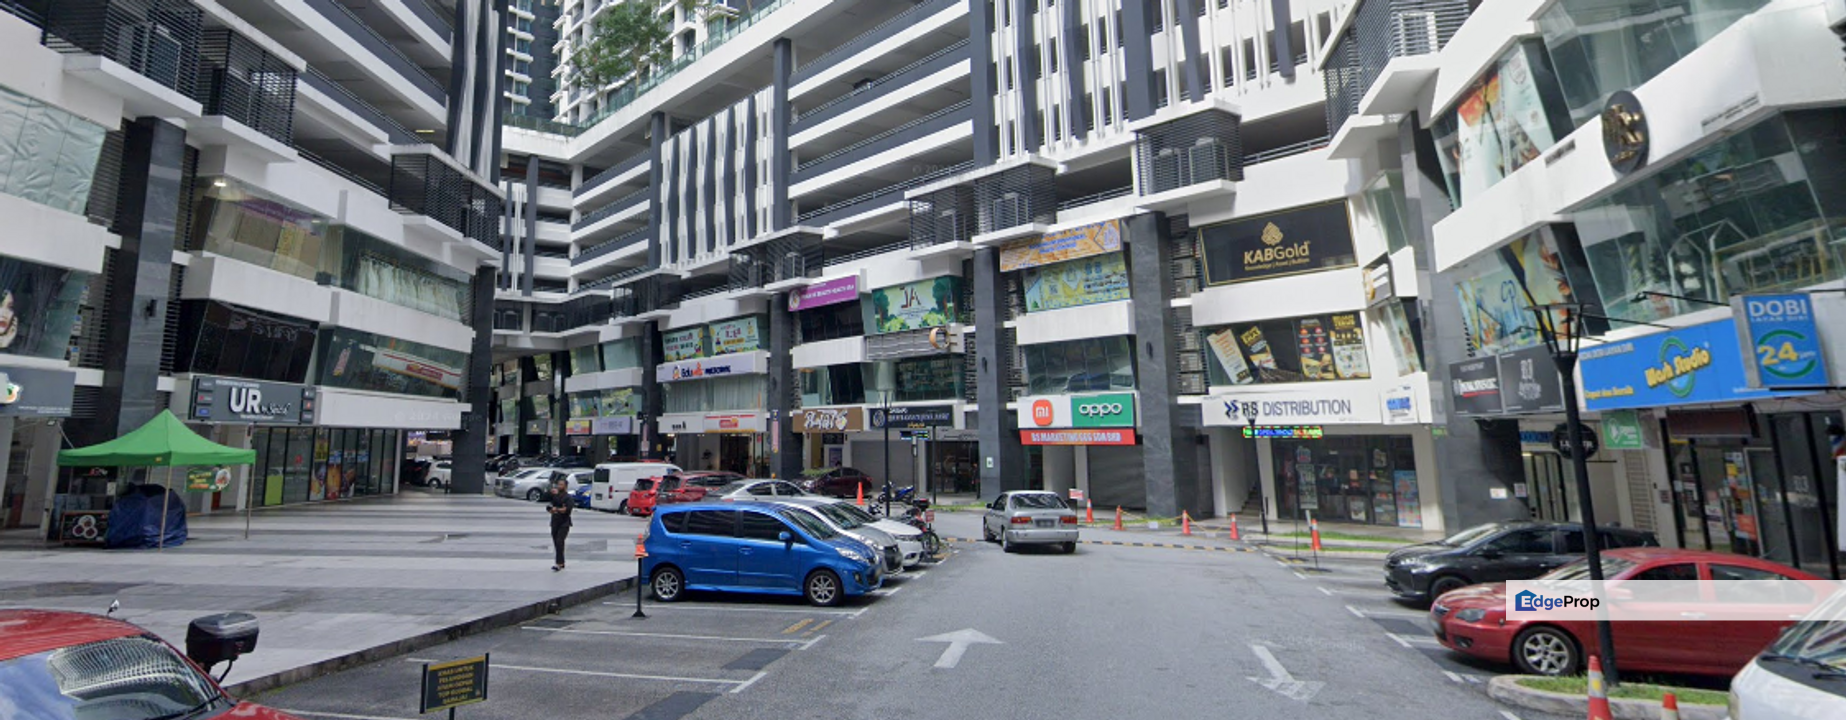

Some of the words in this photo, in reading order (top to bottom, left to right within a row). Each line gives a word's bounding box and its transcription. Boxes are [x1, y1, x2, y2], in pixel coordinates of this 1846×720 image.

[1244, 241, 1310, 265] KABGold
[1748, 299, 1807, 317] DOBI
[1674, 347, 1710, 376] Studio
[1758, 341, 1798, 366] 24
[229, 386, 262, 413] UR
[1262, 399, 1351, 416] DISTRIBUTION
[1041, 432, 1077, 442] MARKETING
